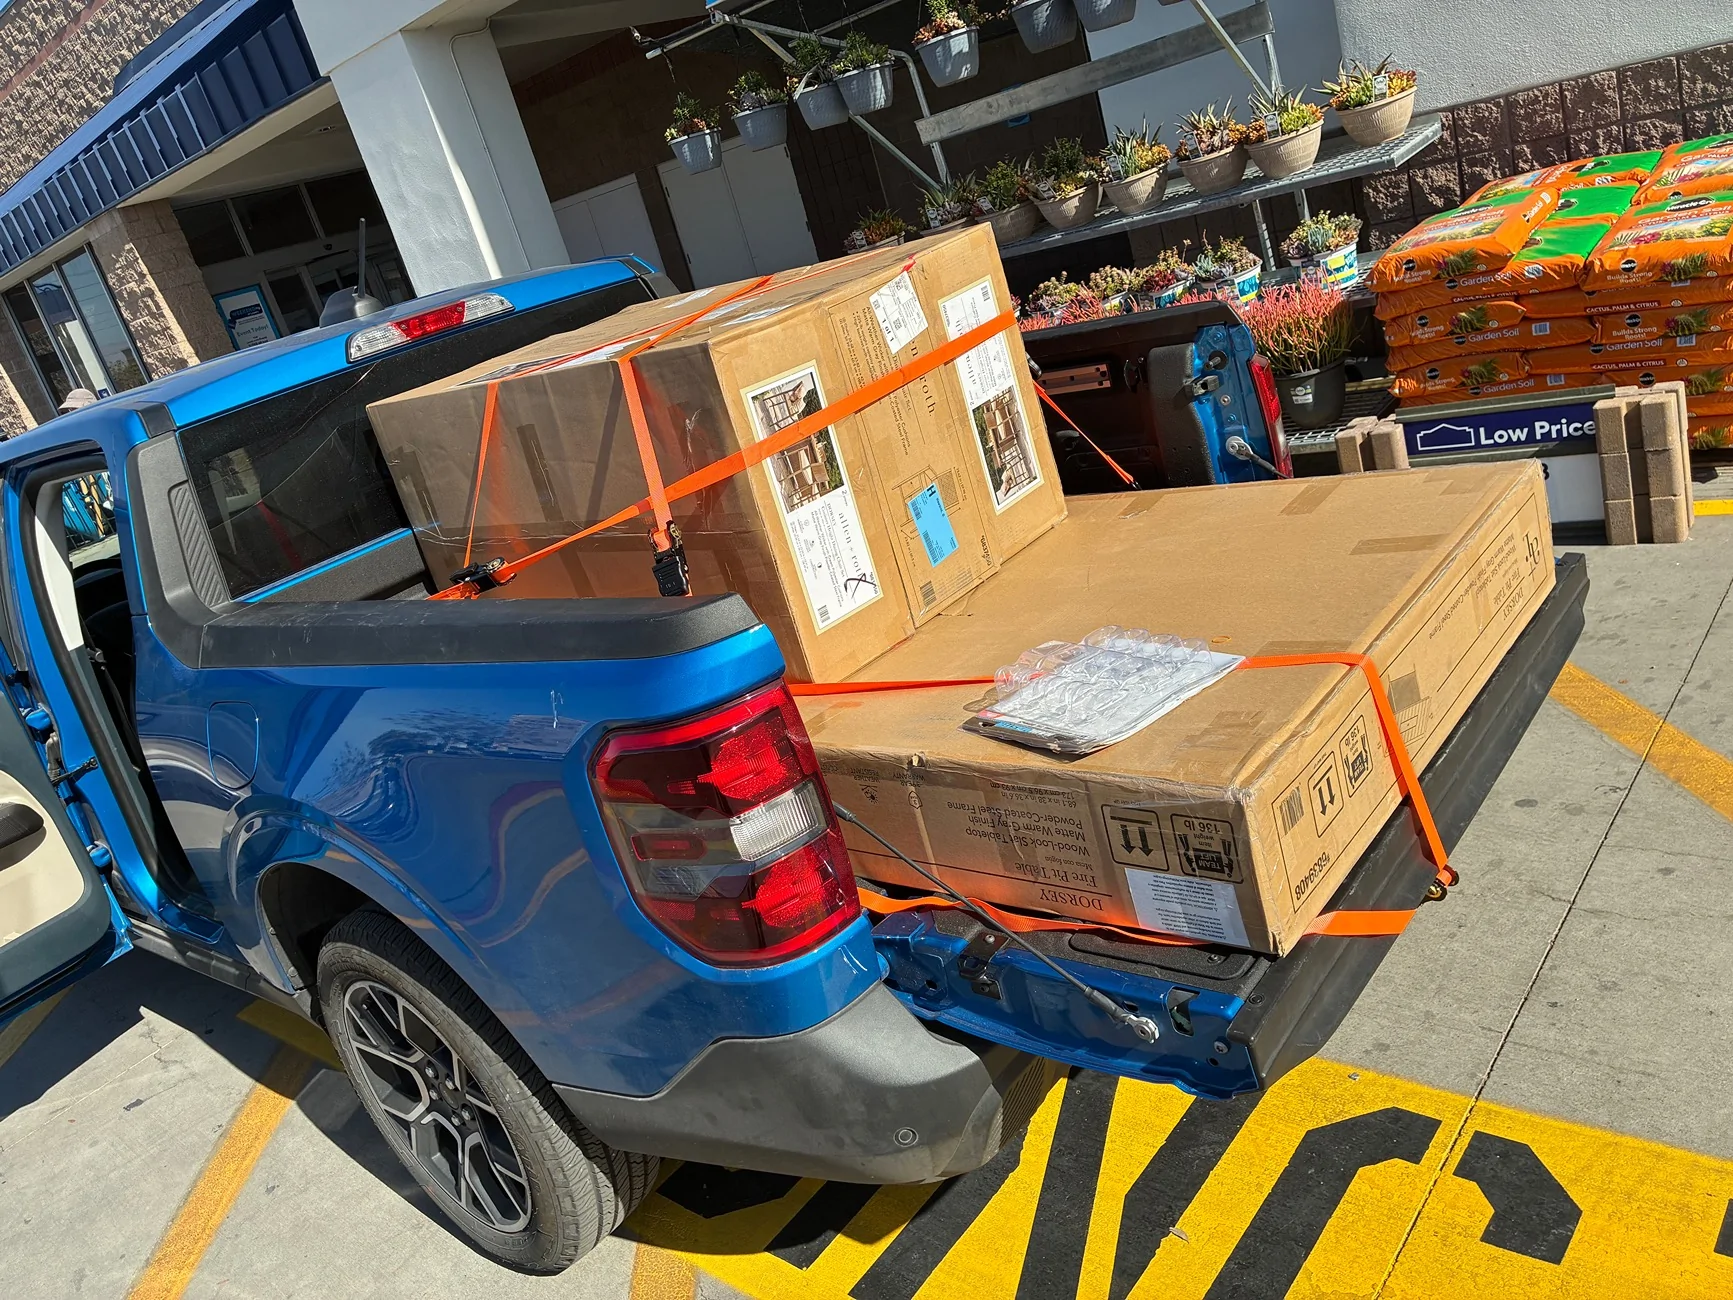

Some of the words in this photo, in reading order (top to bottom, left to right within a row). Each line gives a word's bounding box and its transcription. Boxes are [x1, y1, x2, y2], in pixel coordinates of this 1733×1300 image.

[1460, 275, 1493, 287] Garden
[1630, 271, 1652, 279] Strong
[884, 324, 891, 334] of
[1468, 332, 1502, 342] Garden
[1503, 328, 1520, 337] Soil
[1606, 340, 1643, 351] Garden
[1645, 339, 1662, 347] Soil
[1483, 382, 1517, 393] Garden
[1518, 379, 1535, 388] Soil
[876, 341, 884, 361] Wicker
[901, 422, 910, 447] Cushions
[1479, 425, 1528, 445] Low
[1535, 418, 1596, 440] Price
[926, 485, 935, 497] H
[838, 512, 851, 543] allen
[1503, 587, 1523, 620] DORSEY
[1350, 725, 1359, 740] 136
[1344, 736, 1350, 746] lb
[850, 767, 878, 776] RESISTANT
[892, 772, 925, 780] WARRANTY
[853, 774, 880, 782] WEATHER
[1008, 792, 1023, 800] 36.6
[947, 801, 975, 812] Frame
[977, 805, 1001, 817] Steel
[968, 815, 995, 827] Finish
[997, 817, 1020, 831] Gray
[1004, 809, 1082, 828] Powder-Coated
[1183, 819, 1195, 830] lb
[1022, 823, 1052, 835] Warm
[1198, 822, 1219, 833] 136
[965, 827, 1007, 843] Tabletop
[1008, 834, 1028, 846] Slat
[1055, 827, 1085, 841] Matte
[1030, 838, 1089, 855] Wood-Look
[1199, 852, 1216, 861] LIFT
[1015, 862, 1050, 878] Table
[1075, 861, 1092, 870] Mesa
[1197, 859, 1221, 869] TEAM
[1051, 868, 1069, 882] Pit
[1071, 872, 1097, 887] Fire
[1295, 852, 1329, 899] #6839408
[1040, 889, 1102, 910] DORSEY
